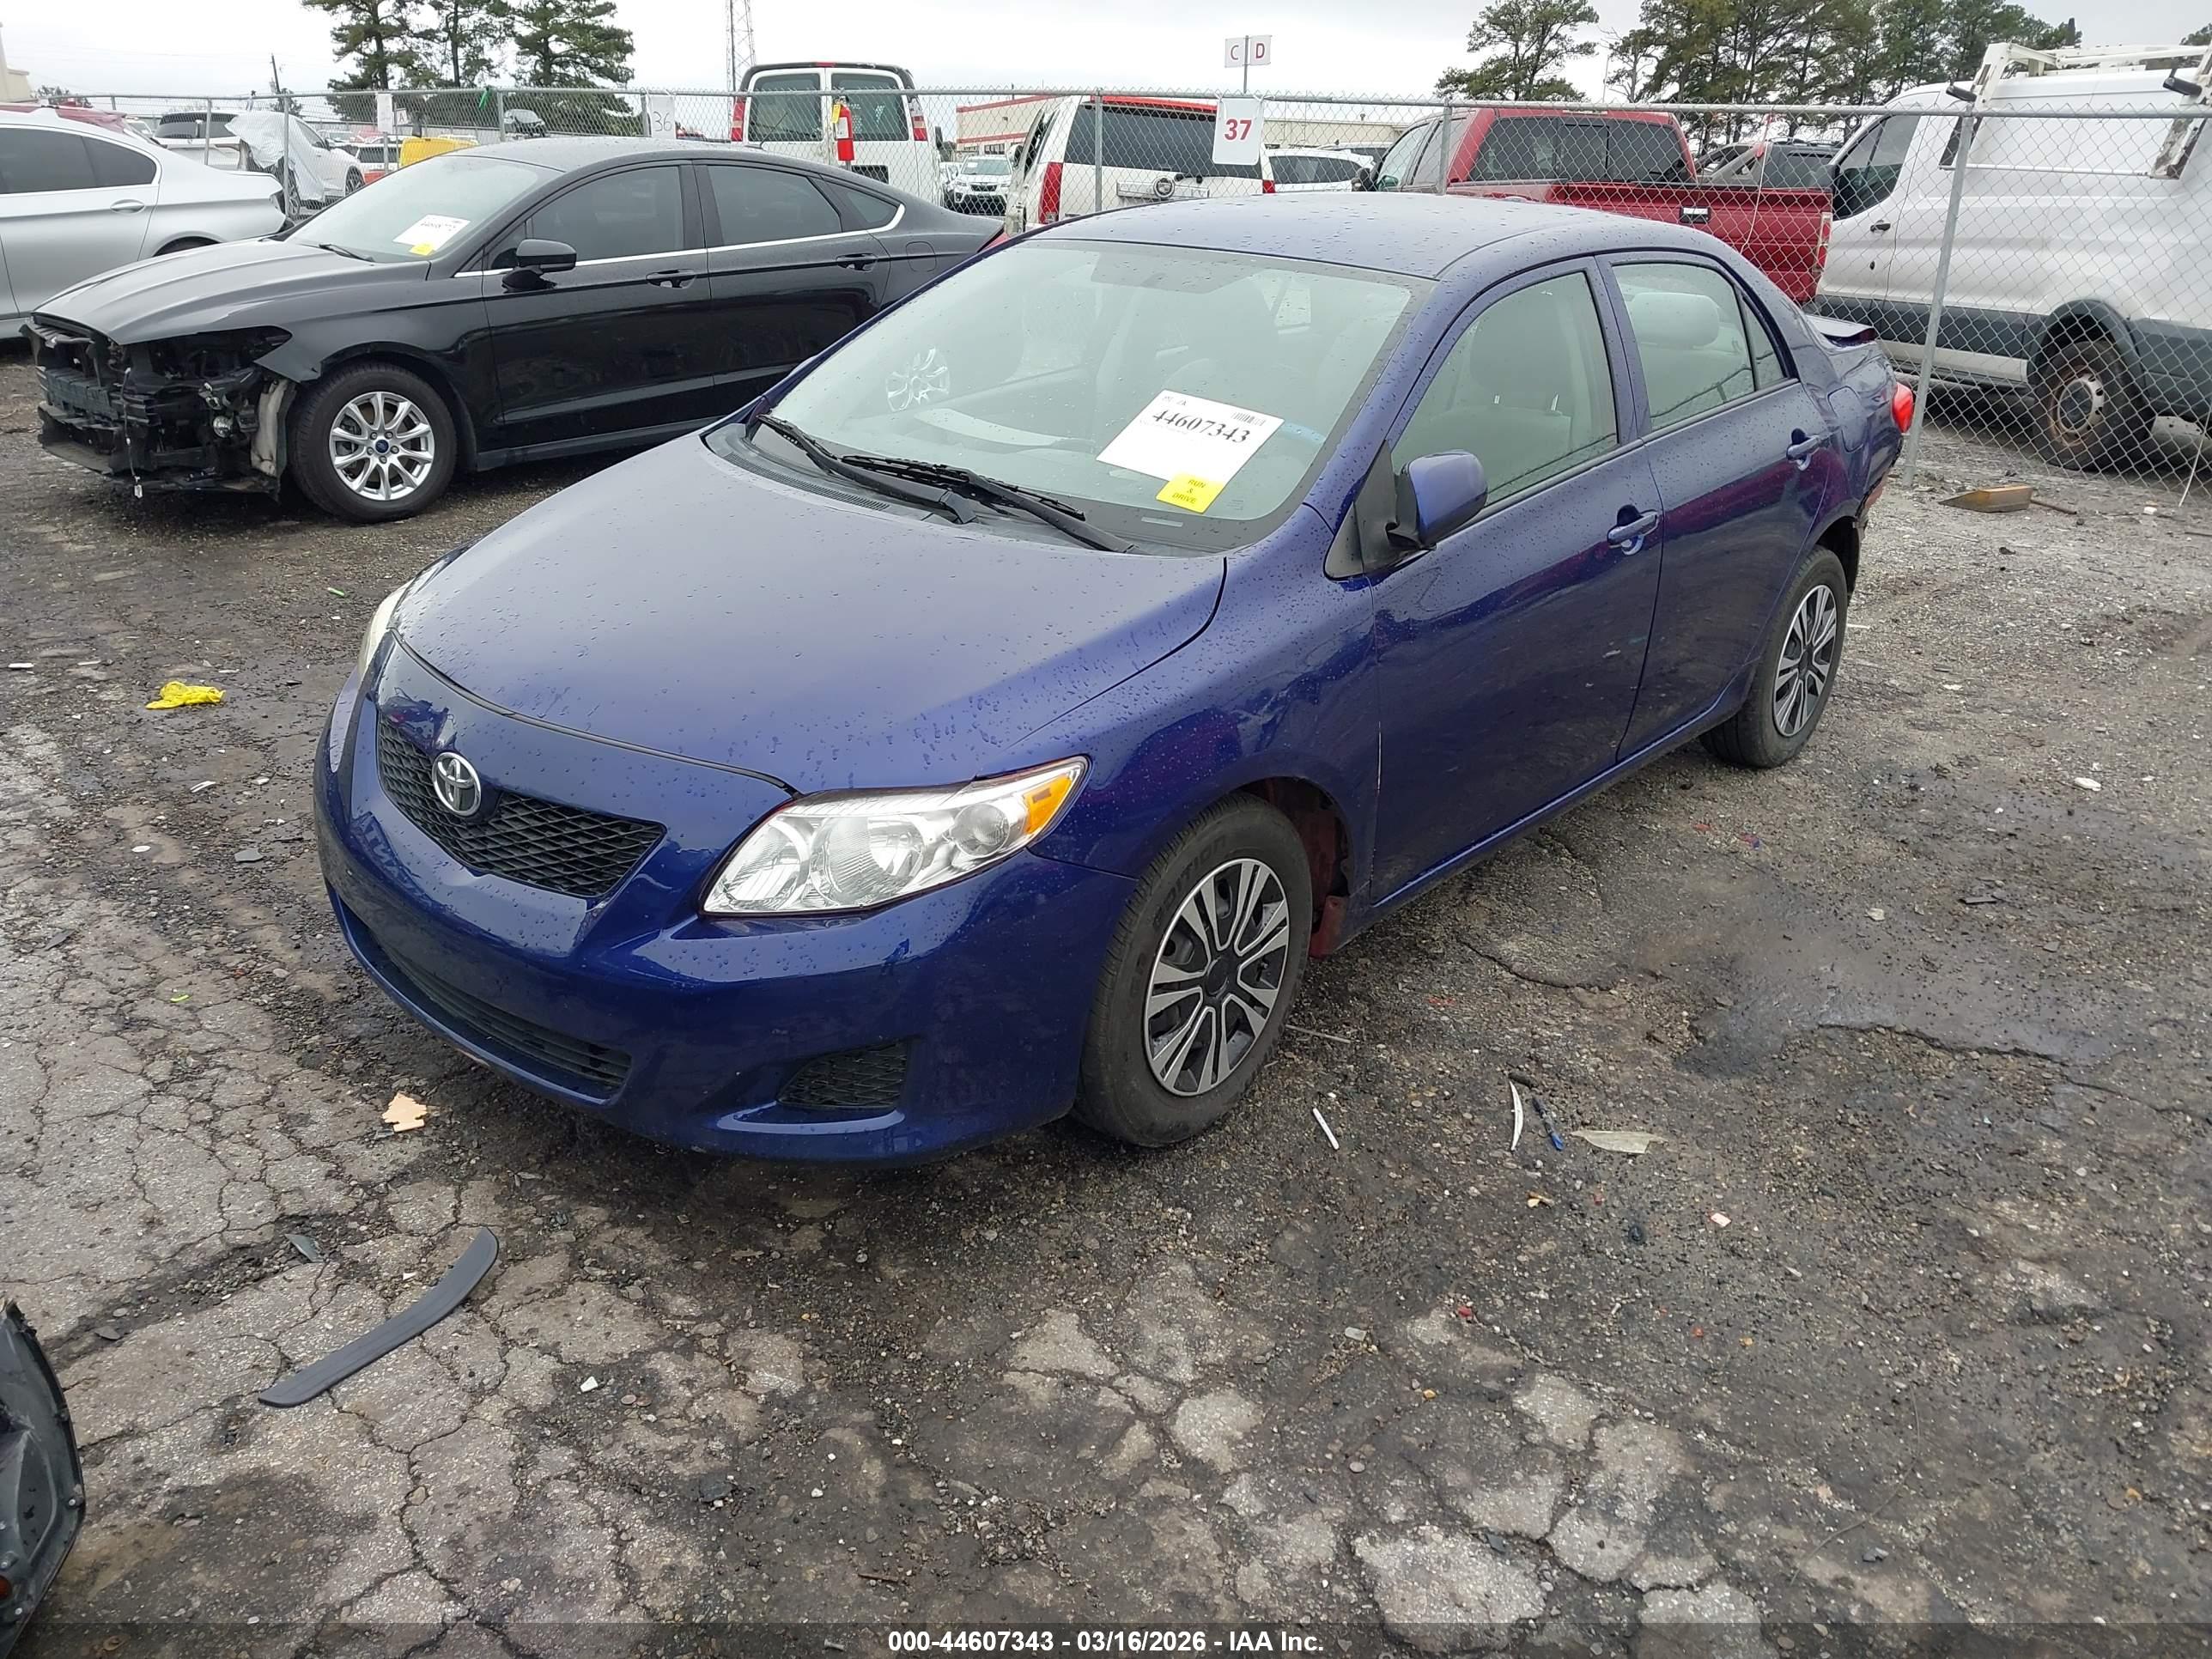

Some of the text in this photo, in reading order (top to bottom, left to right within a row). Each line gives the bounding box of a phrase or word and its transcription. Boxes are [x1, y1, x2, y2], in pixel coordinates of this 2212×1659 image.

[1231, 45, 1239, 60] C
[1255, 43, 1265, 58] D
[653, 111, 672, 131] 36
[1224, 118, 1252, 141] 37
[1152, 410, 1250, 442] 44607343
[1188, 479, 1206, 489] RUN
[1172, 492, 1197, 503] DRIVE
